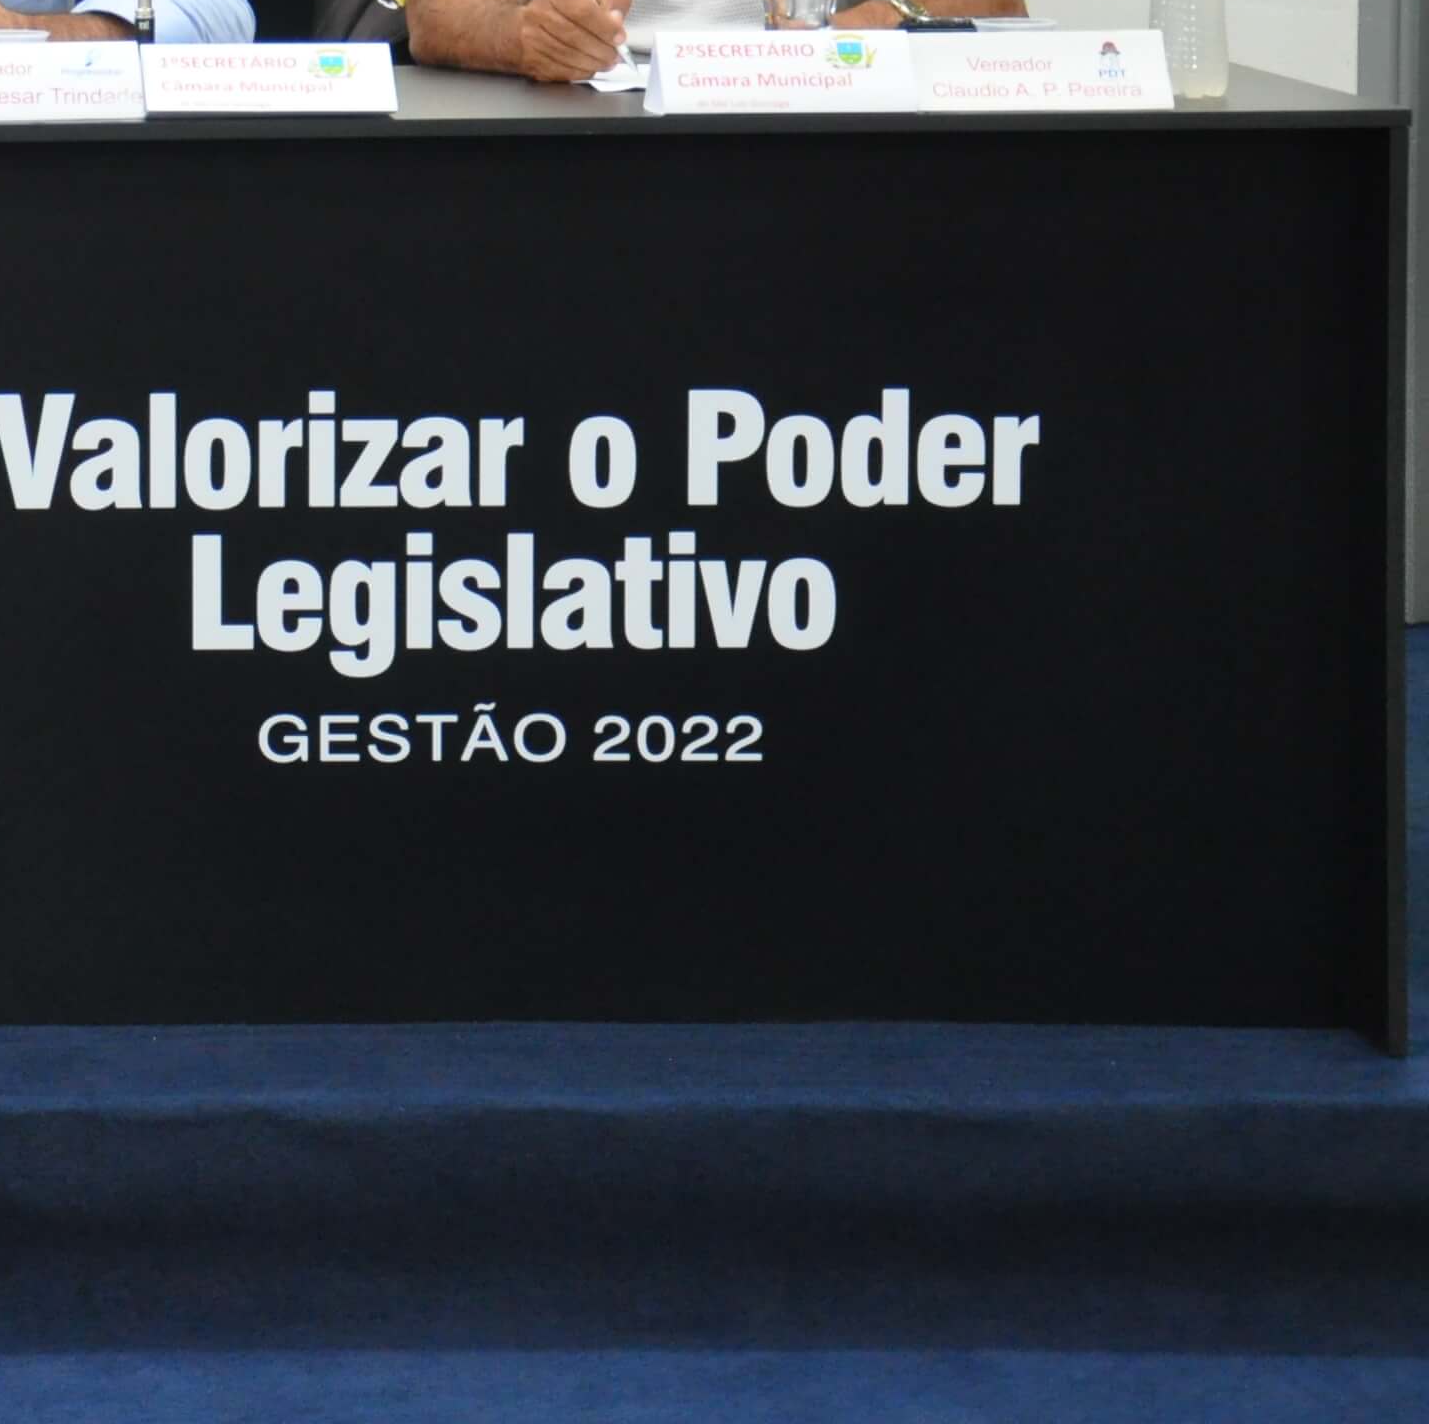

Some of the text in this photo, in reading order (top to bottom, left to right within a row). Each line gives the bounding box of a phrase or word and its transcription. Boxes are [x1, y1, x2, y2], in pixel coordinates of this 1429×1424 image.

[966, 56, 1053, 73] Vereador
[677, 72, 854, 90] Câmara Municipal
[1098, 68, 1126, 79] PDT
[161, 80, 334, 95] Câmara Municipal
[932, 81, 1010, 98] Claudio
[1067, 81, 1143, 98] Pereira
[569, 415, 637, 509] o
[688, 388, 1040, 508] Poder
[191, 530, 837, 678] Legislativo
[258, 702, 763, 764] GESTÃO 2022
